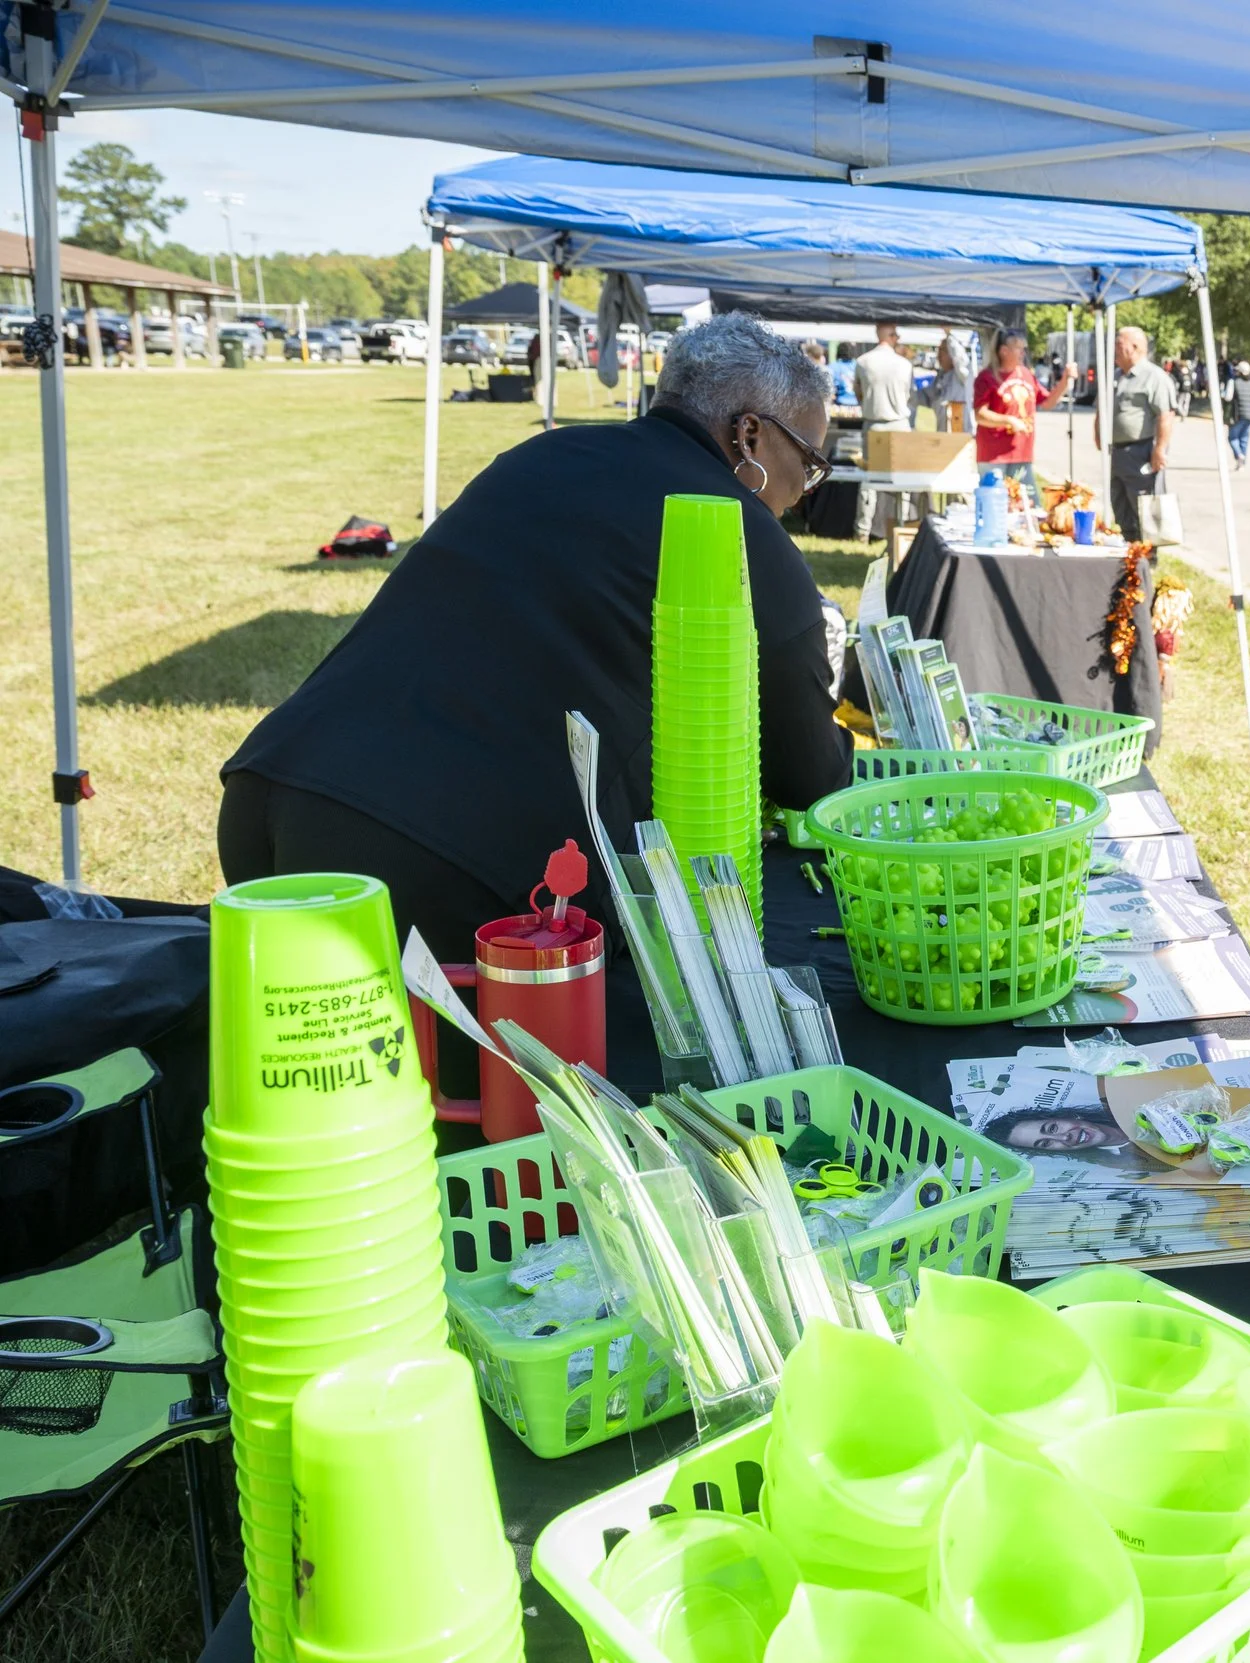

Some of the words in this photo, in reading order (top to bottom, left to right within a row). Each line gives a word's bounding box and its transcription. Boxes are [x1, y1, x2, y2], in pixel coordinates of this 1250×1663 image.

[265, 980, 393, 1017] 1-877-685-2415
[303, 1018, 328, 1029] Line
[333, 1009, 372, 1024] Service
[353, 1014, 392, 1032] Member
[277, 1030, 336, 1043] Recipient
[340, 1026, 349, 1036] &
[260, 1052, 322, 1064] RESOURCES
[325, 1045, 362, 1059] HEALTH
[261, 1058, 373, 1093] Trillium
[1033, 1078, 1065, 1109] rillium
